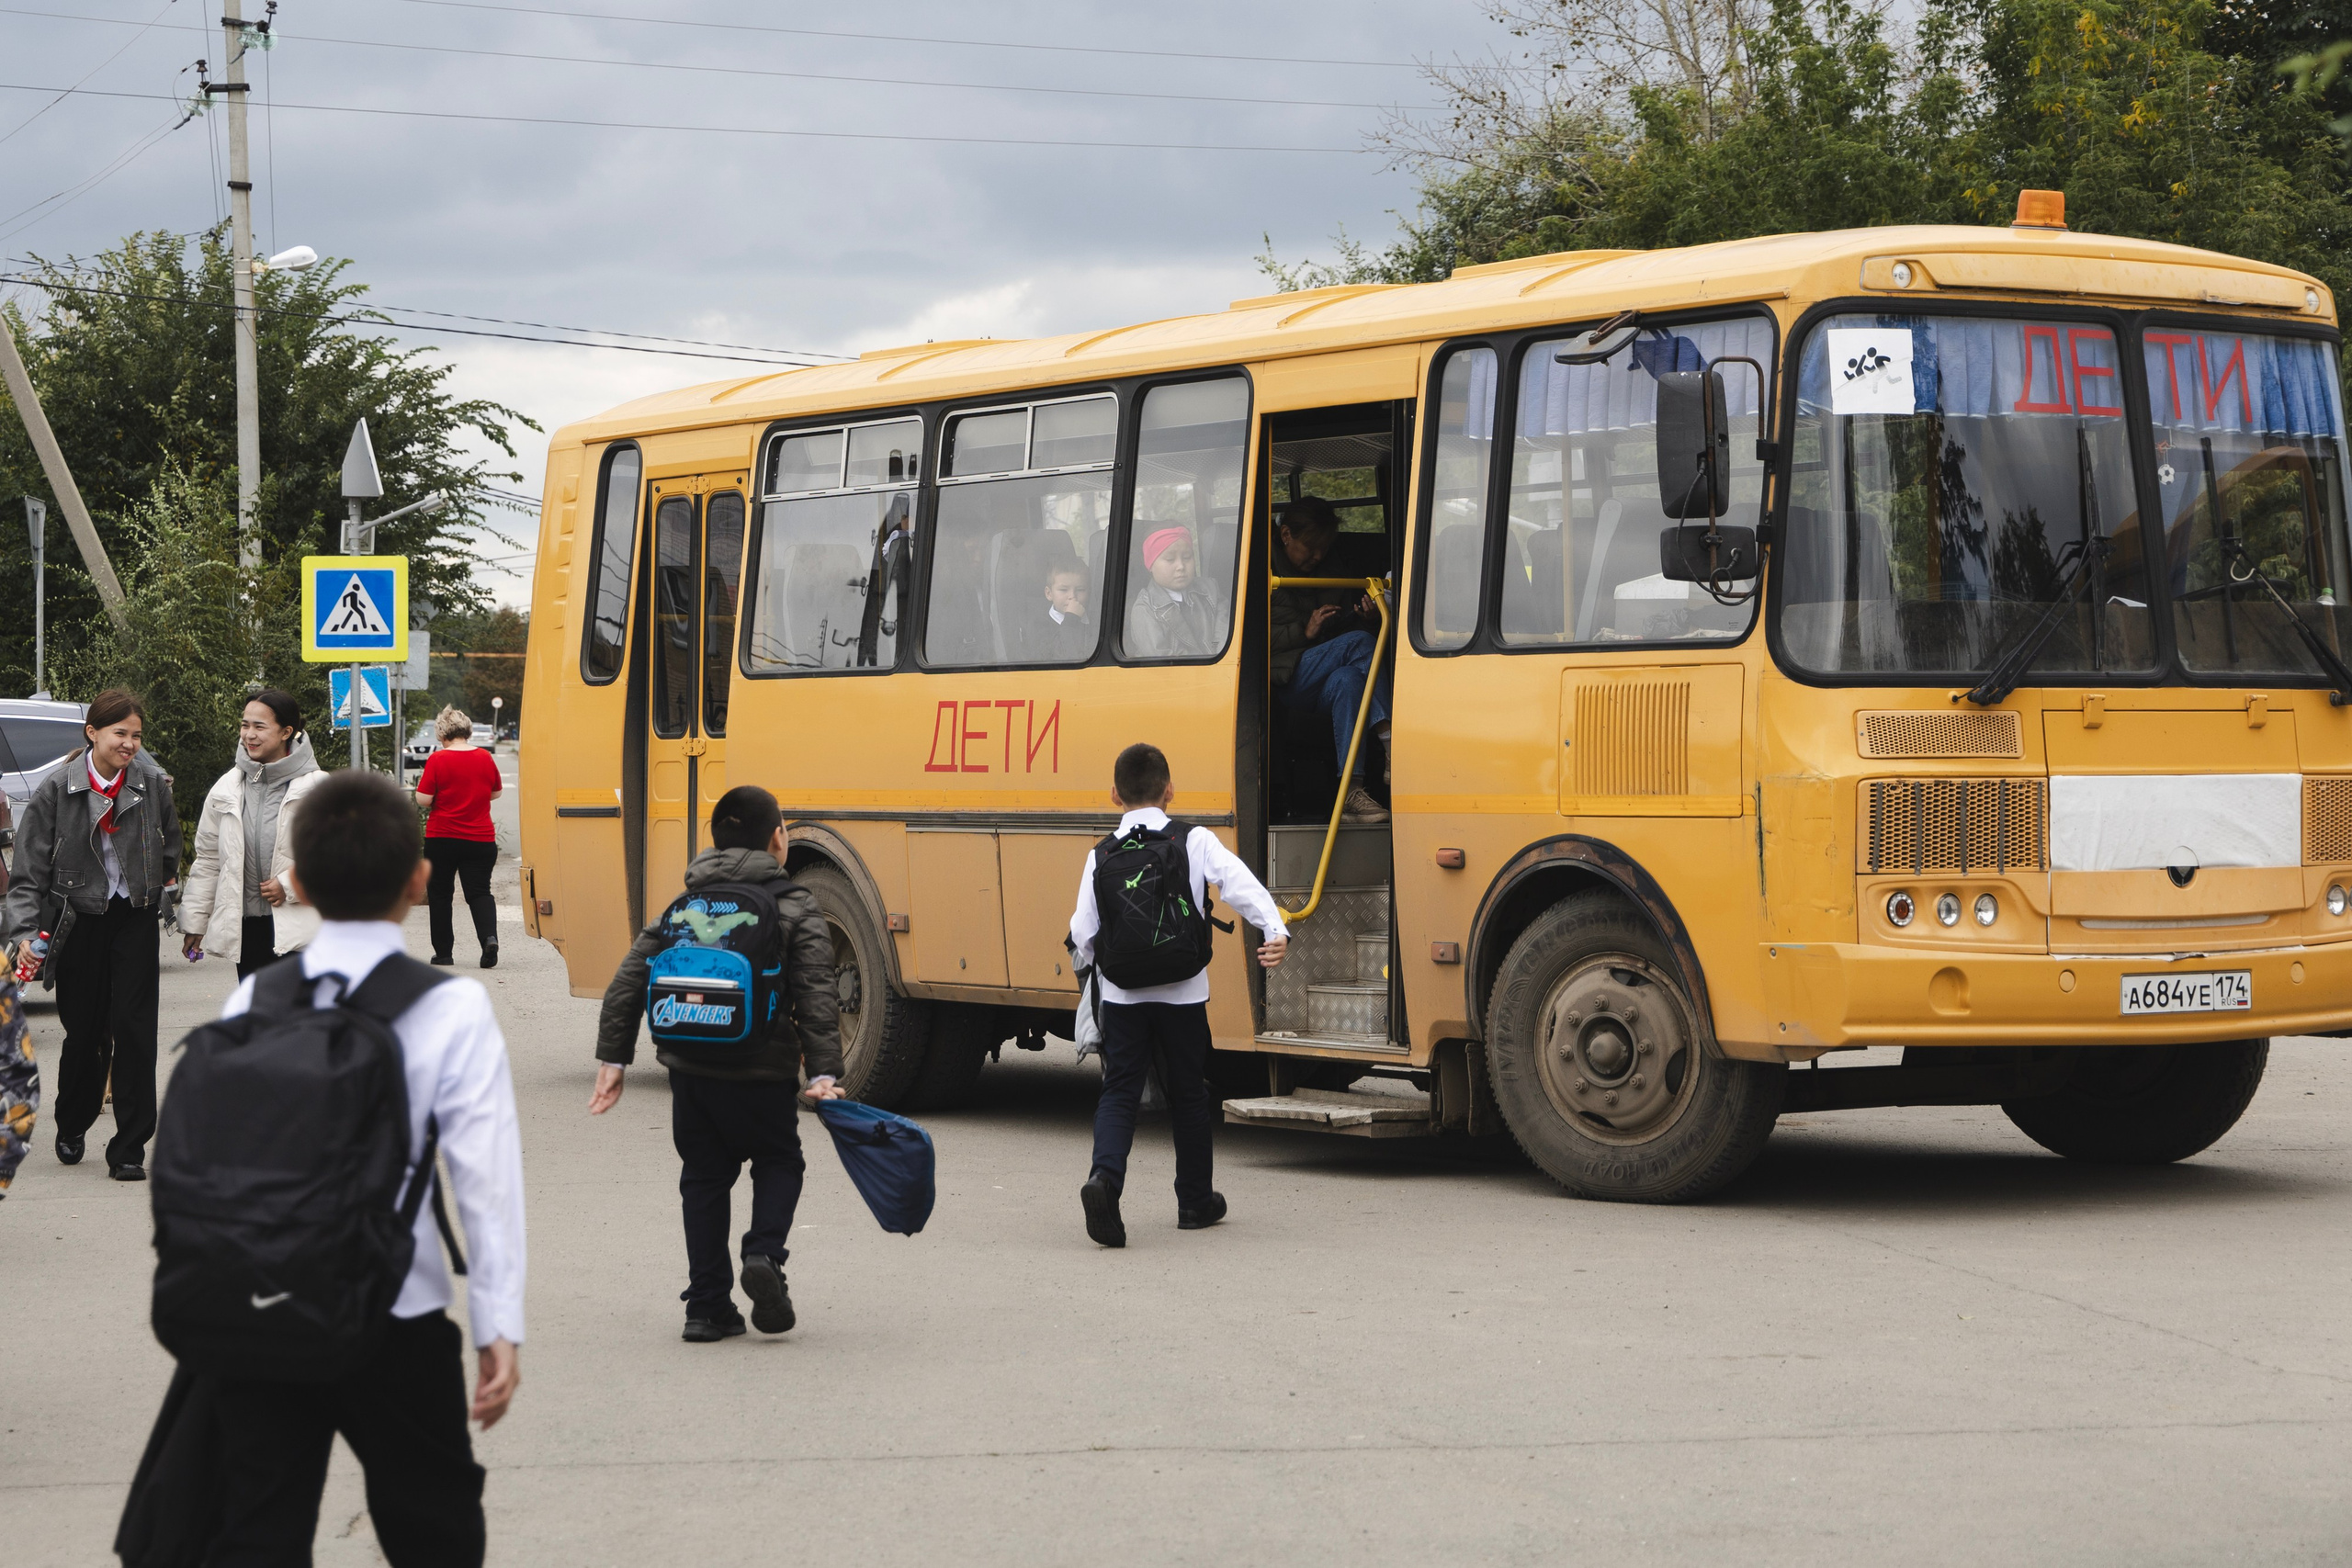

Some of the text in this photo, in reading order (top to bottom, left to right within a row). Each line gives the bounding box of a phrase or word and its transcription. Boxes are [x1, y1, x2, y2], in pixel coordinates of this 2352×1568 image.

[2014, 326, 2253, 423] ДЕТИ
[924, 699, 1060, 773] ДЕТИ
[2129, 976, 2245, 1009] А684УЕ 174
[2222, 998, 2237, 1007] RUS
[653, 994, 736, 1027] AVENGERS
